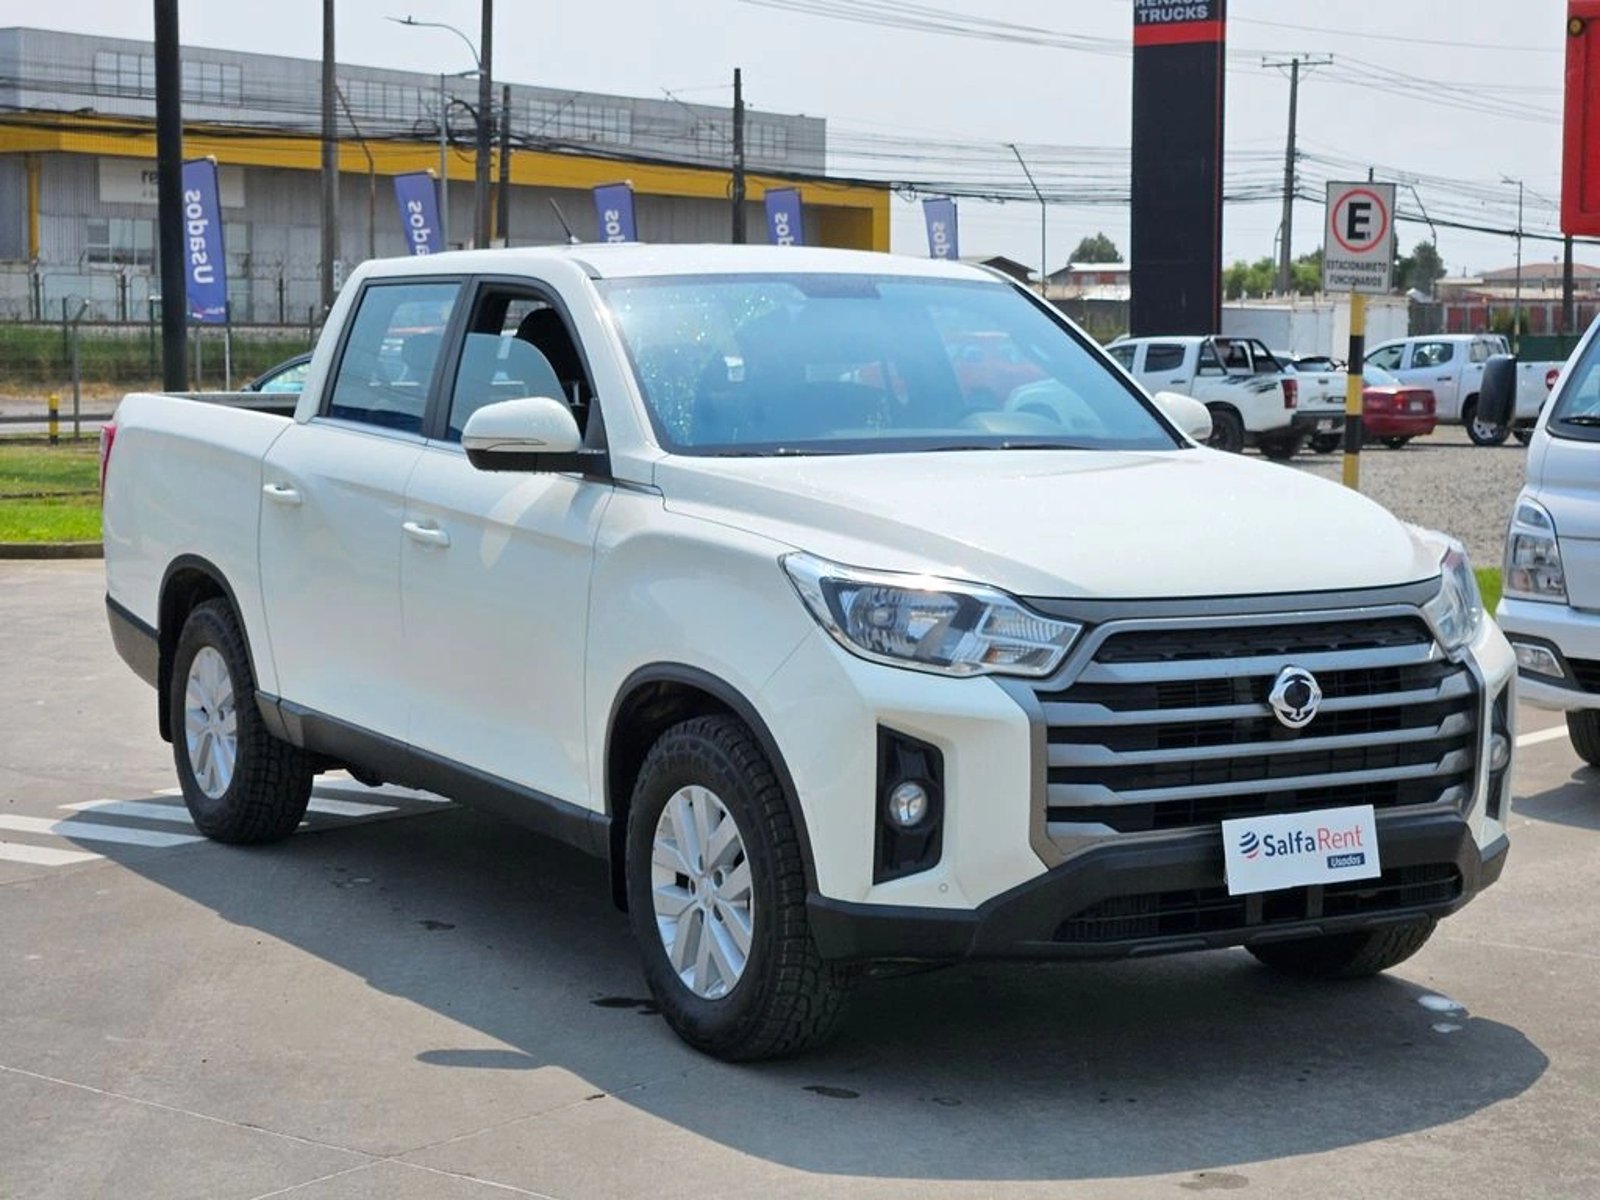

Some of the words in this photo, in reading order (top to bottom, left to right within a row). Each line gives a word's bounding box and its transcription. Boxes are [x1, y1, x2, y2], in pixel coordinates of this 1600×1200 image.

[1139, 5, 1209, 22] TRUCKS
[1347, 202, 1371, 240] E
[1263, 825, 1364, 857] SalfaRent
[1330, 855, 1361, 867] Usados
